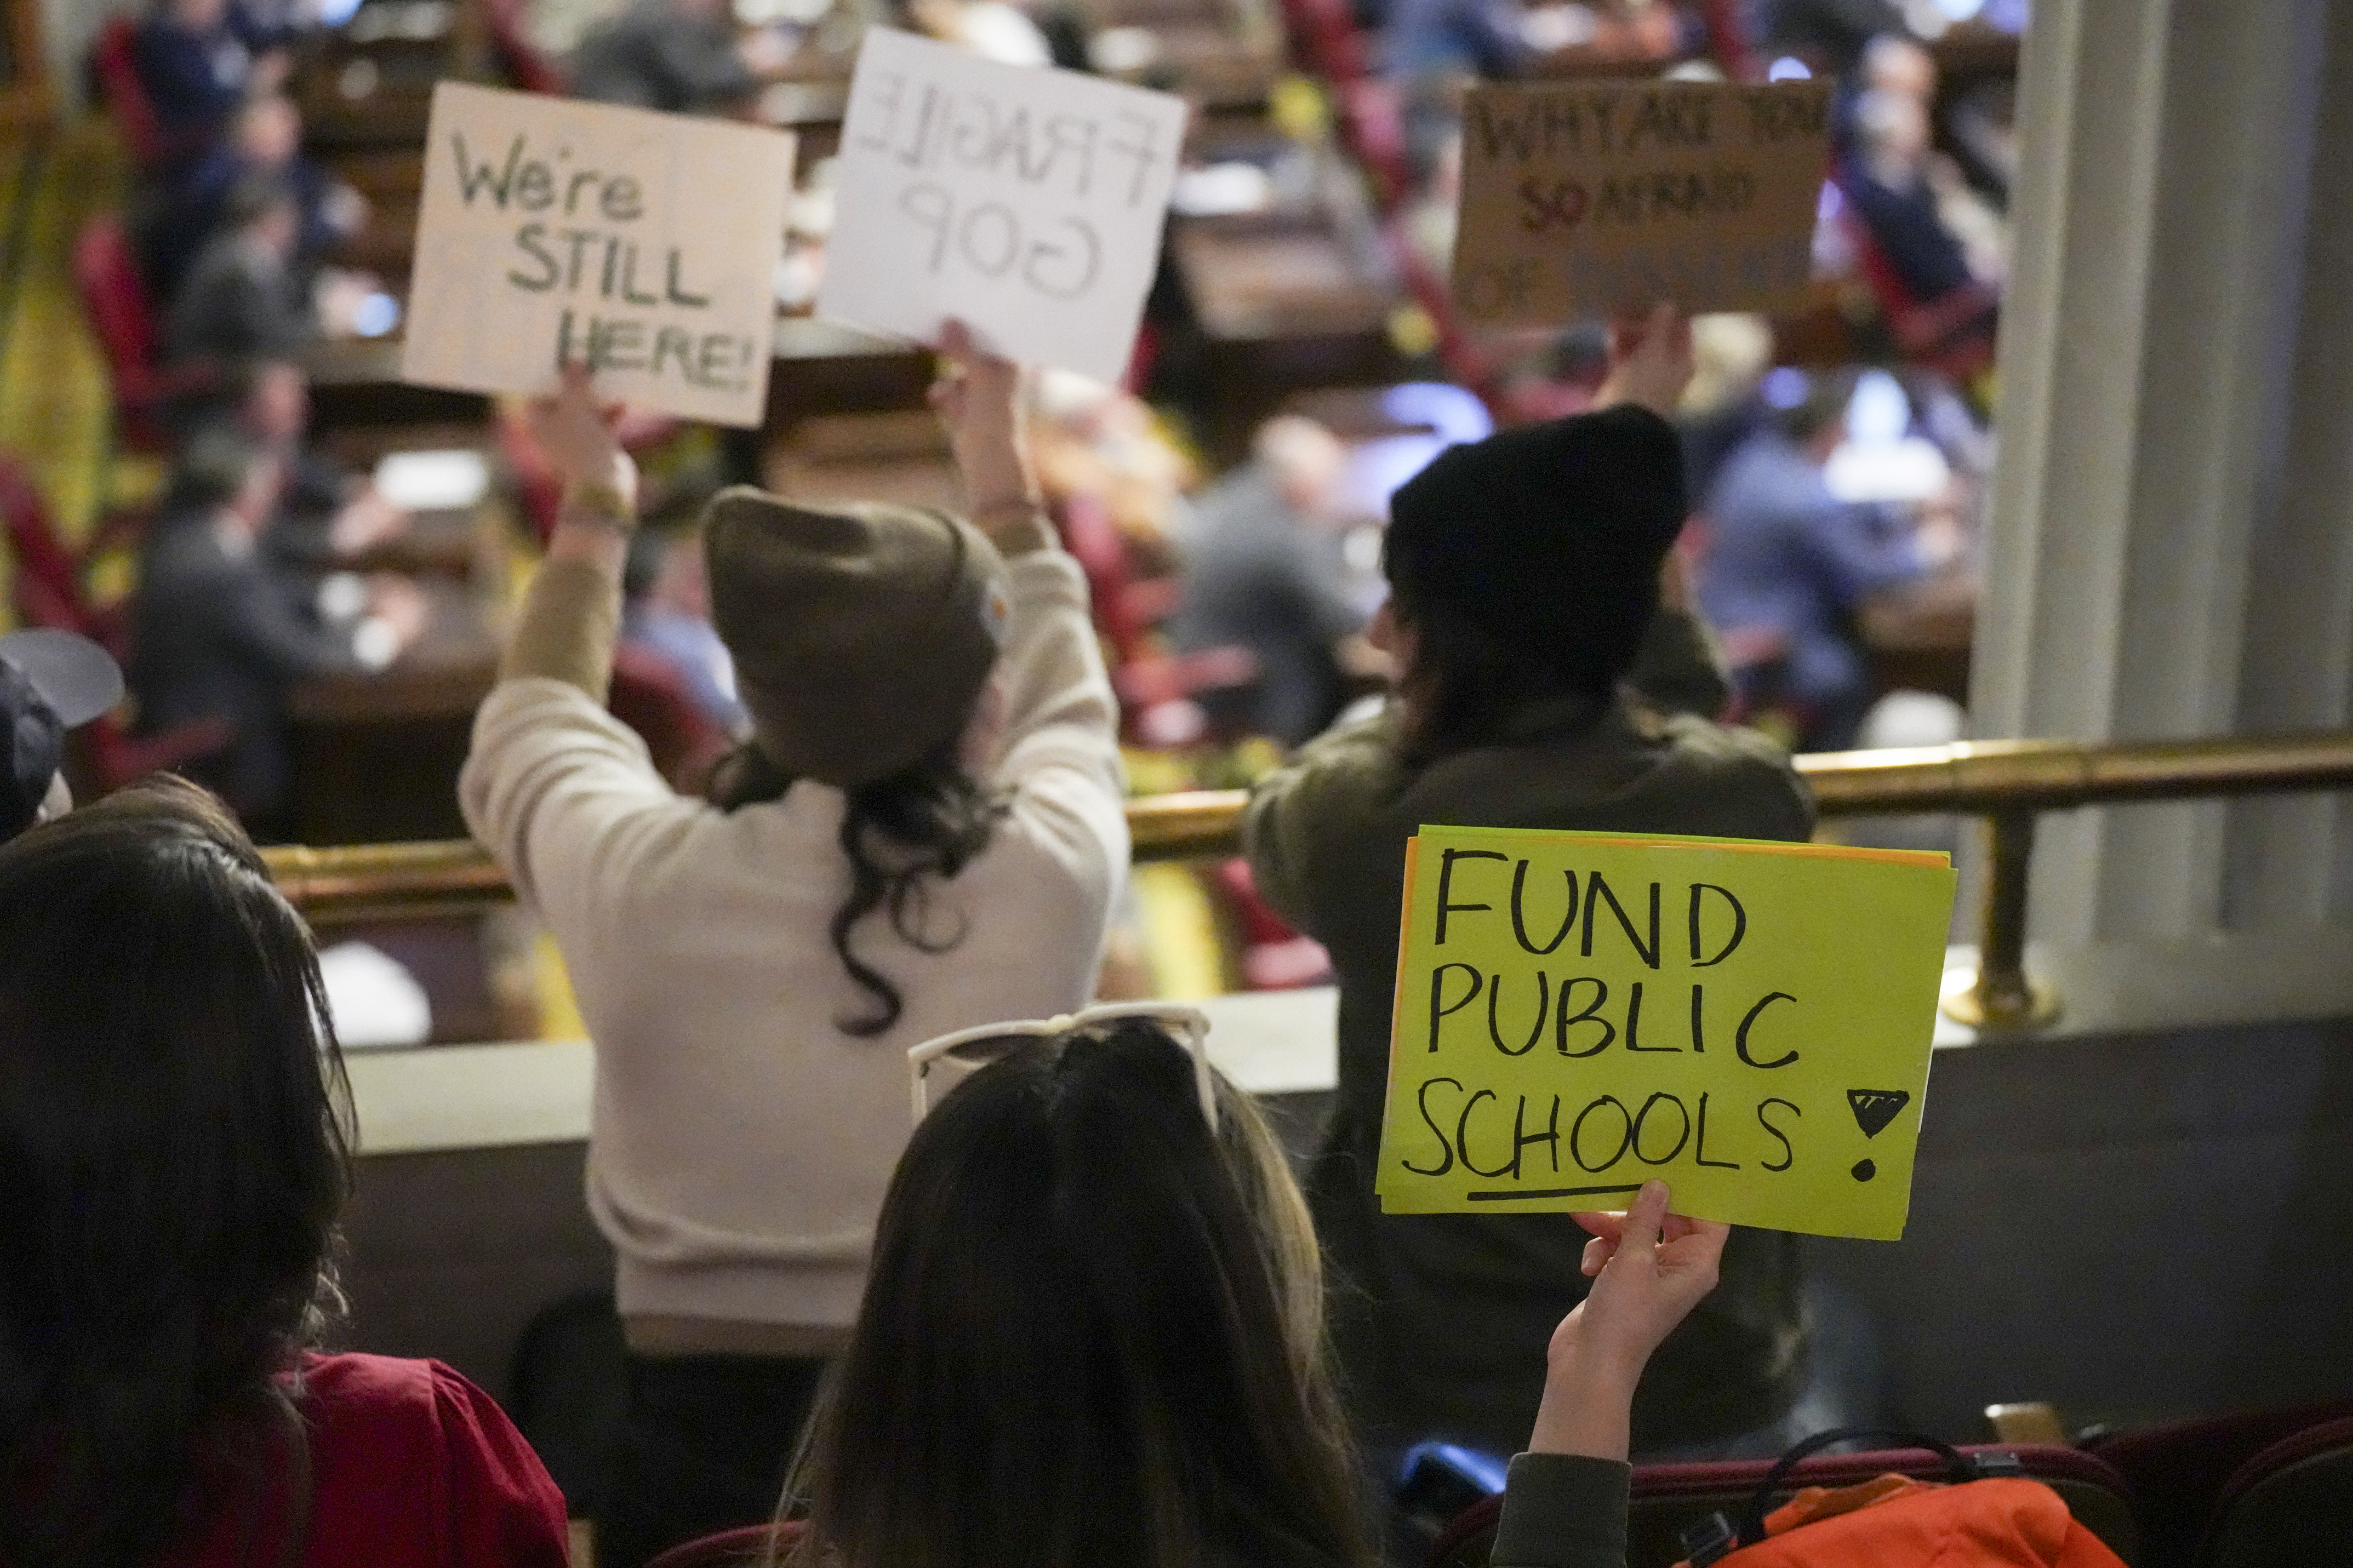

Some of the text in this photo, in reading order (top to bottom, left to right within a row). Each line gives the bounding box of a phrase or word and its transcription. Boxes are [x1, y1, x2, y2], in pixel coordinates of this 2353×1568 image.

[1471, 92, 1625, 161] WHY
[1623, 88, 1712, 146] ARE
[452, 131, 643, 221] We're
[1516, 171, 1757, 233] SO AFRAID
[506, 222, 709, 308] STILL
[556, 309, 756, 391] HERE!
[1434, 847, 1747, 970] FUND
[1427, 963, 1800, 1069] PUBLIC
[1401, 1077, 1801, 1180] SCHOOLS
